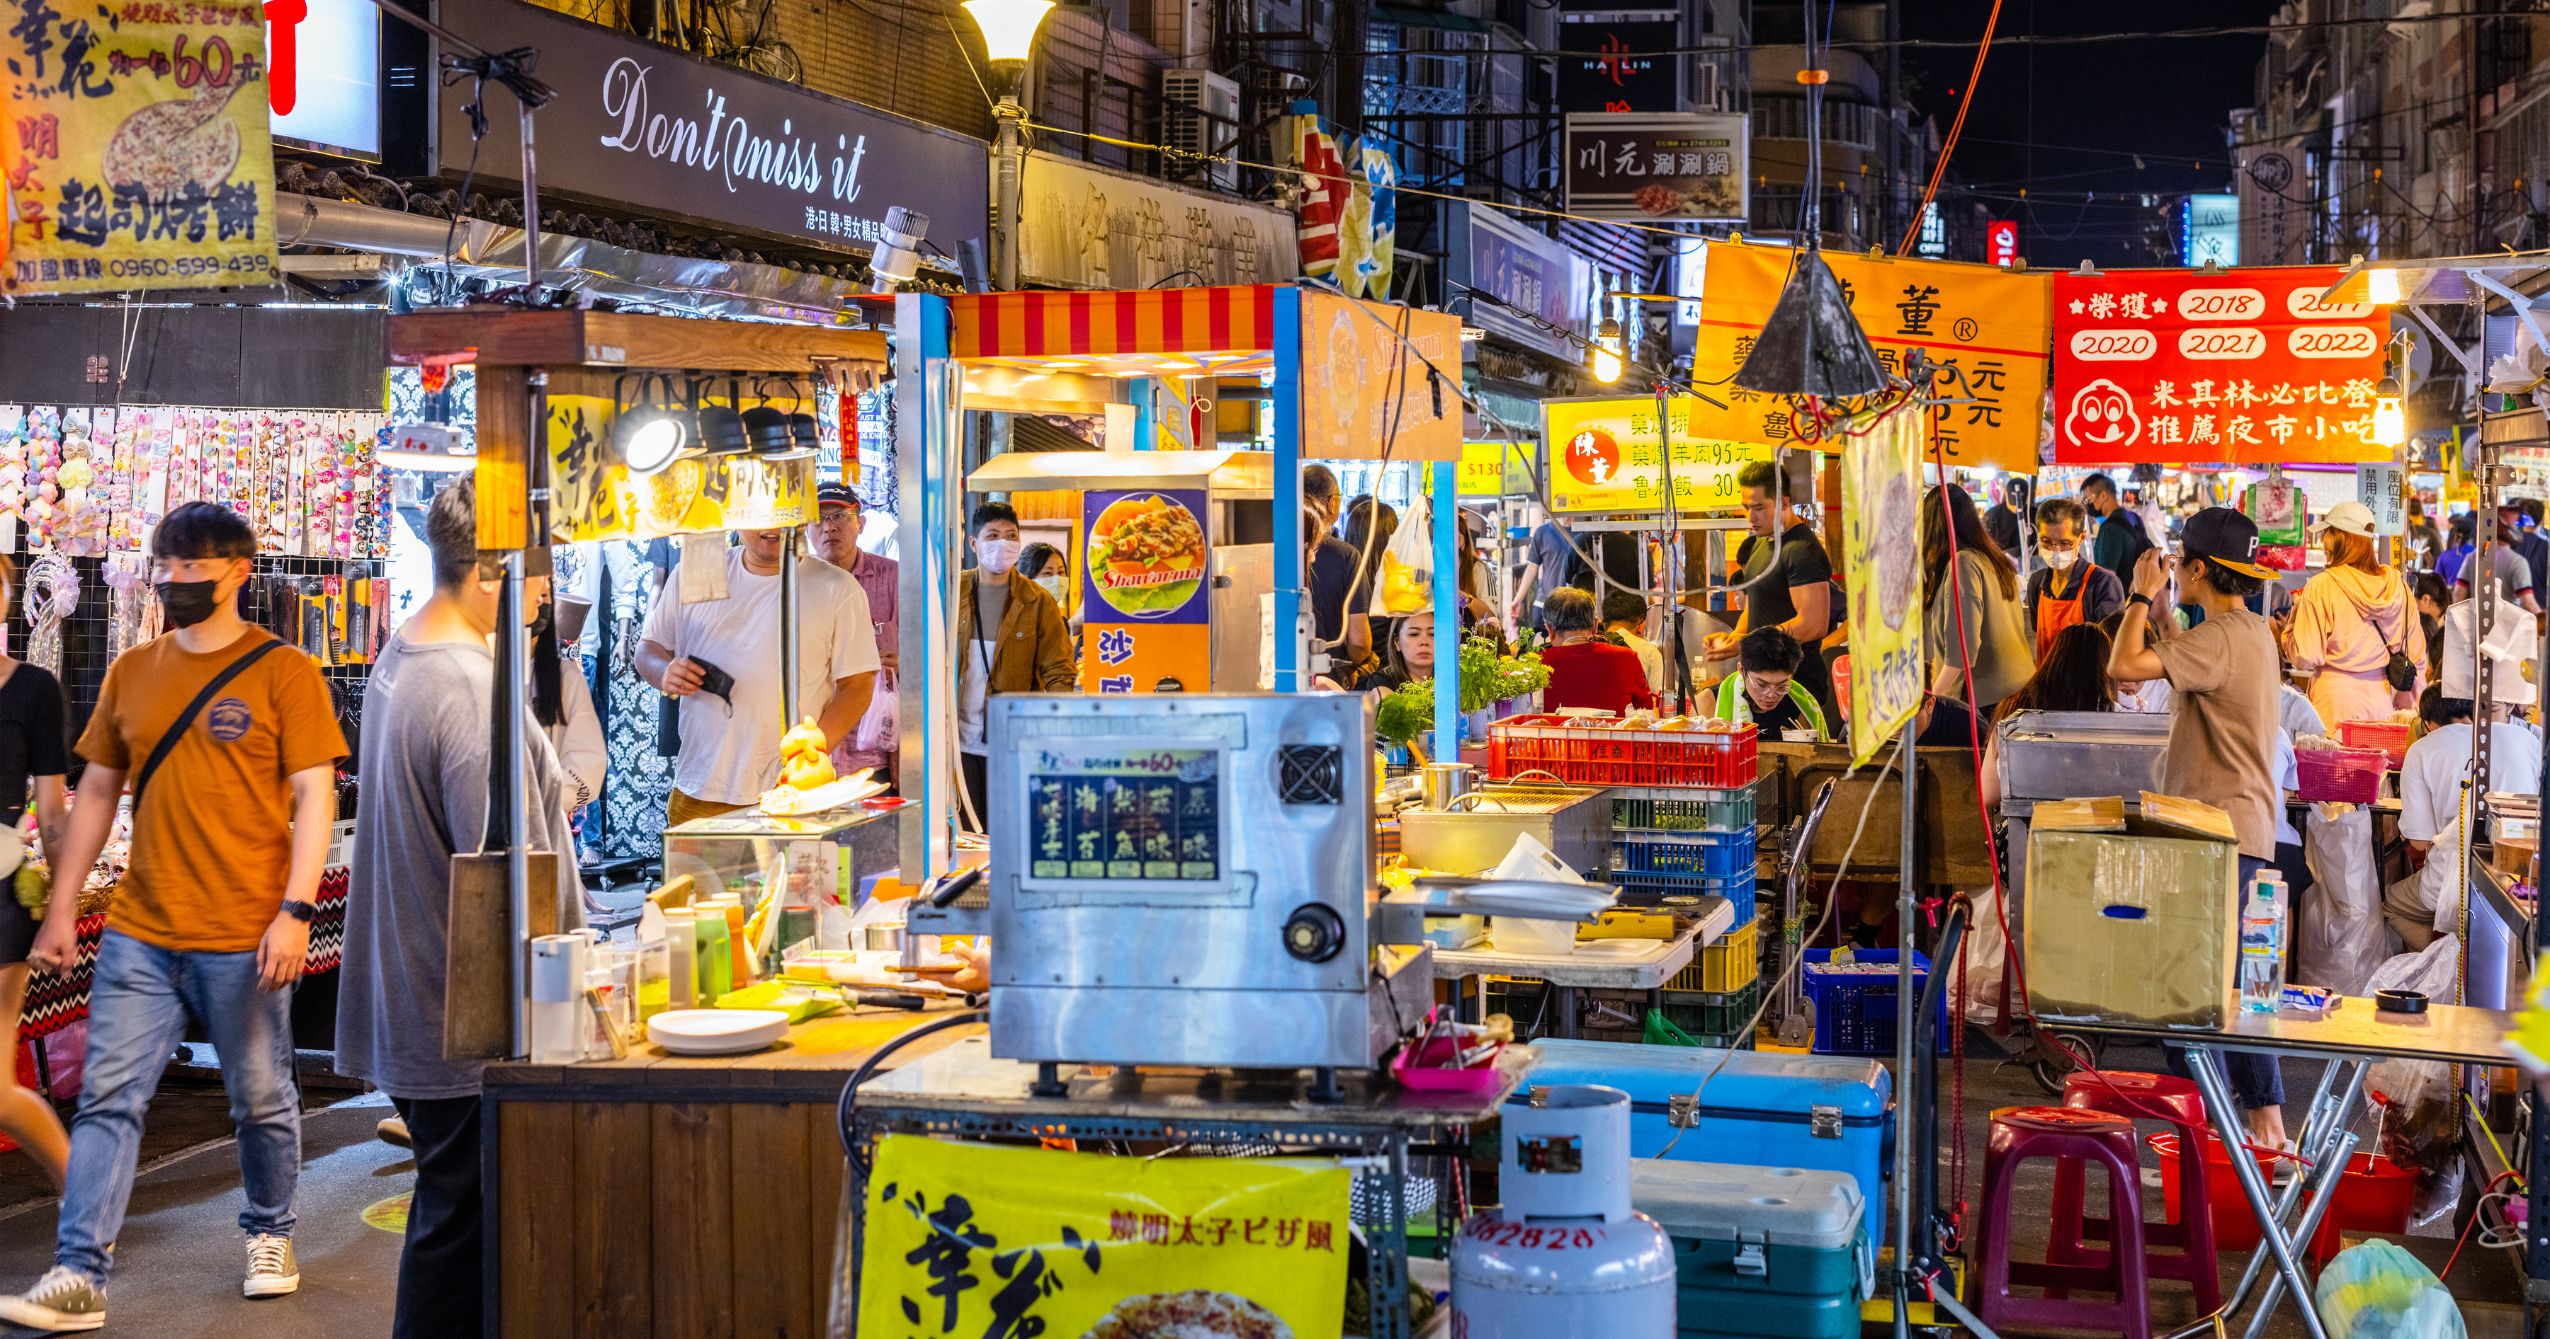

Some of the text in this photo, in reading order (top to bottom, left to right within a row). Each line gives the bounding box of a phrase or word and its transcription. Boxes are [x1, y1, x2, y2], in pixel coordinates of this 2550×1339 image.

[601, 57, 866, 203] Don't miss it
[1580, 139, 1730, 178] 川元 涮涮鍋
[12, 113, 59, 240] 明太子
[55, 177, 259, 248] 起司烤餅
[15, 256, 103, 282] 加盟專線
[2087, 292, 2153, 320] 榮獲
[2187, 295, 2256, 315] 2018
[2079, 333, 2370, 355] 2020 2021 2022
[2149, 377, 2378, 410] 米其林必比登
[2386, 469, 2401, 525] 座位有限
[2248, 537, 2260, 558] P
[1099, 567, 1202, 590] Shawarma
